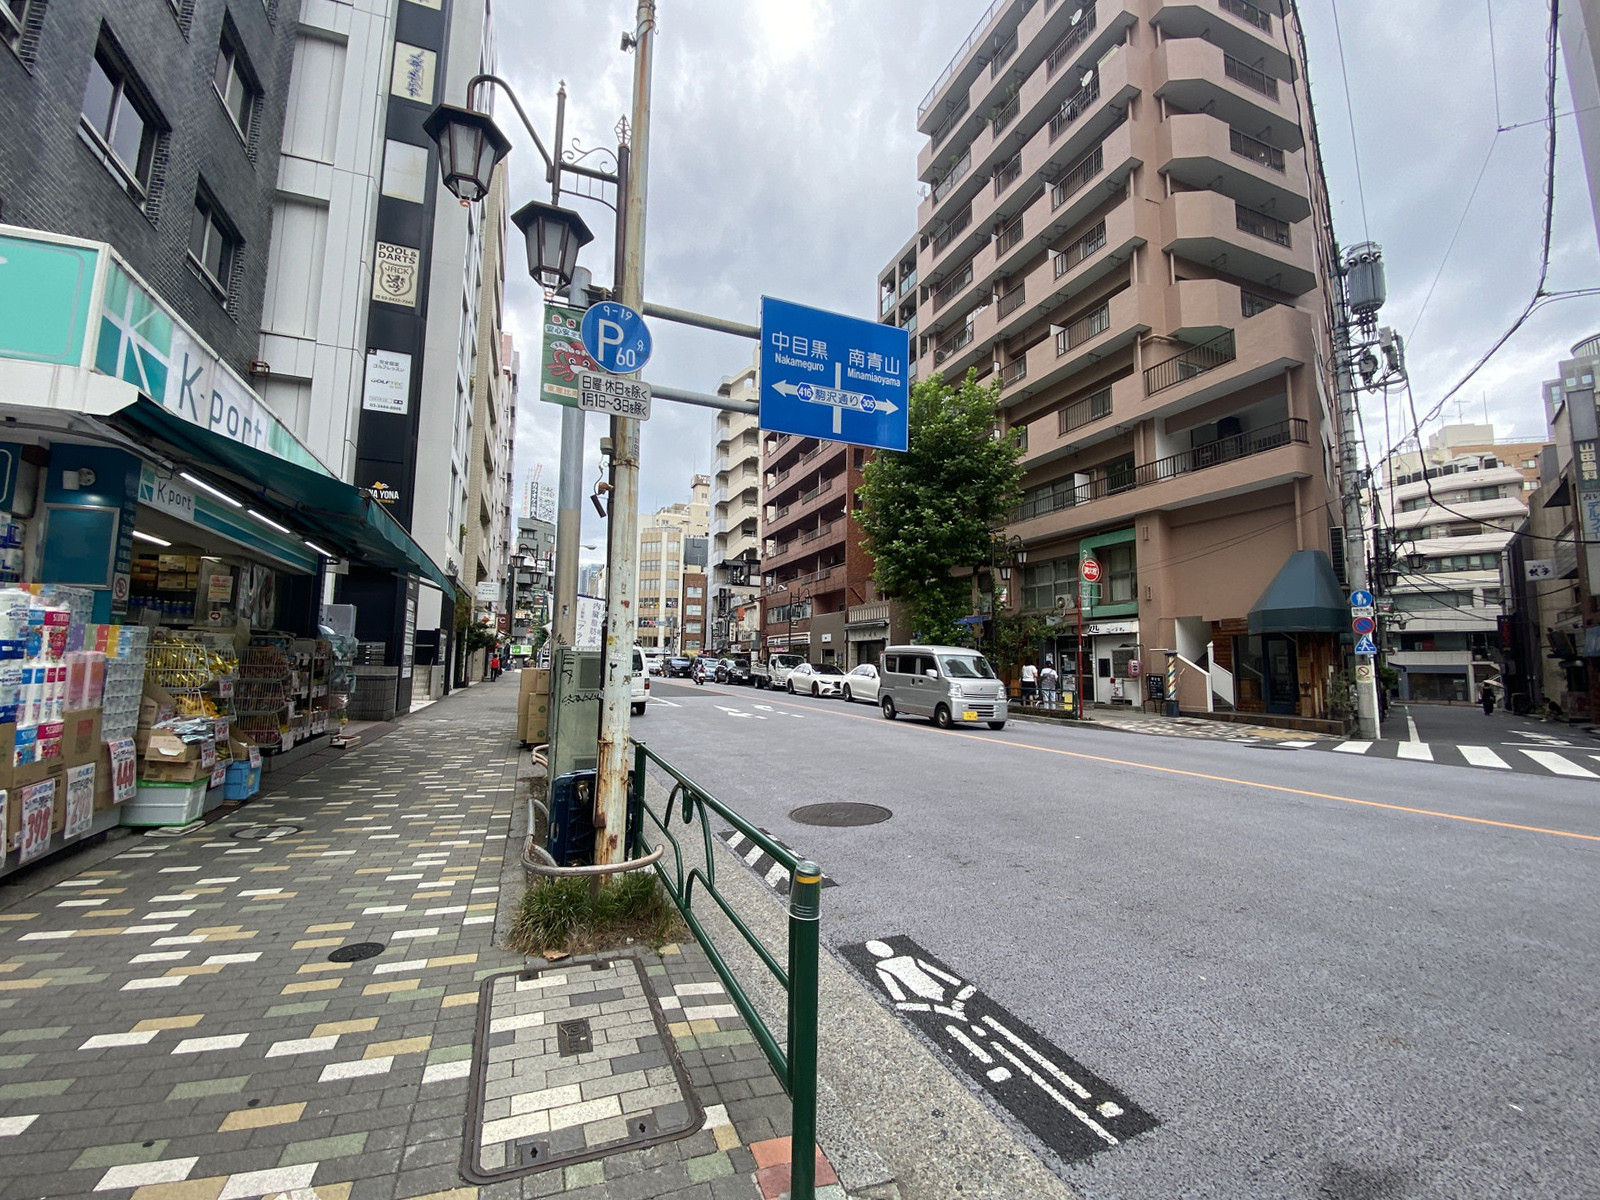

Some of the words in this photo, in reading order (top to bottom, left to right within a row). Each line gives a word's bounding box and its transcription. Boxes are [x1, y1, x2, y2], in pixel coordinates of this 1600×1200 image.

[378, 244, 409, 257] POOL
[378, 251, 416, 265] DARTS
[384, 265, 409, 275] JACK
[603, 305, 633, 321] 9-19
[598, 318, 624, 362] P
[771, 331, 828, 361] 中目黒
[775, 352, 824, 372] Nakameguro
[848, 348, 900, 375] 南青山
[847, 368, 901, 387] Minamiaoyama
[799, 386, 812, 397] 416
[815, 388, 859, 406] 駒沢通り
[862, 399, 875, 409] 305
[157, 482, 192, 510] K-port
[379, 490, 400, 500] YONA
